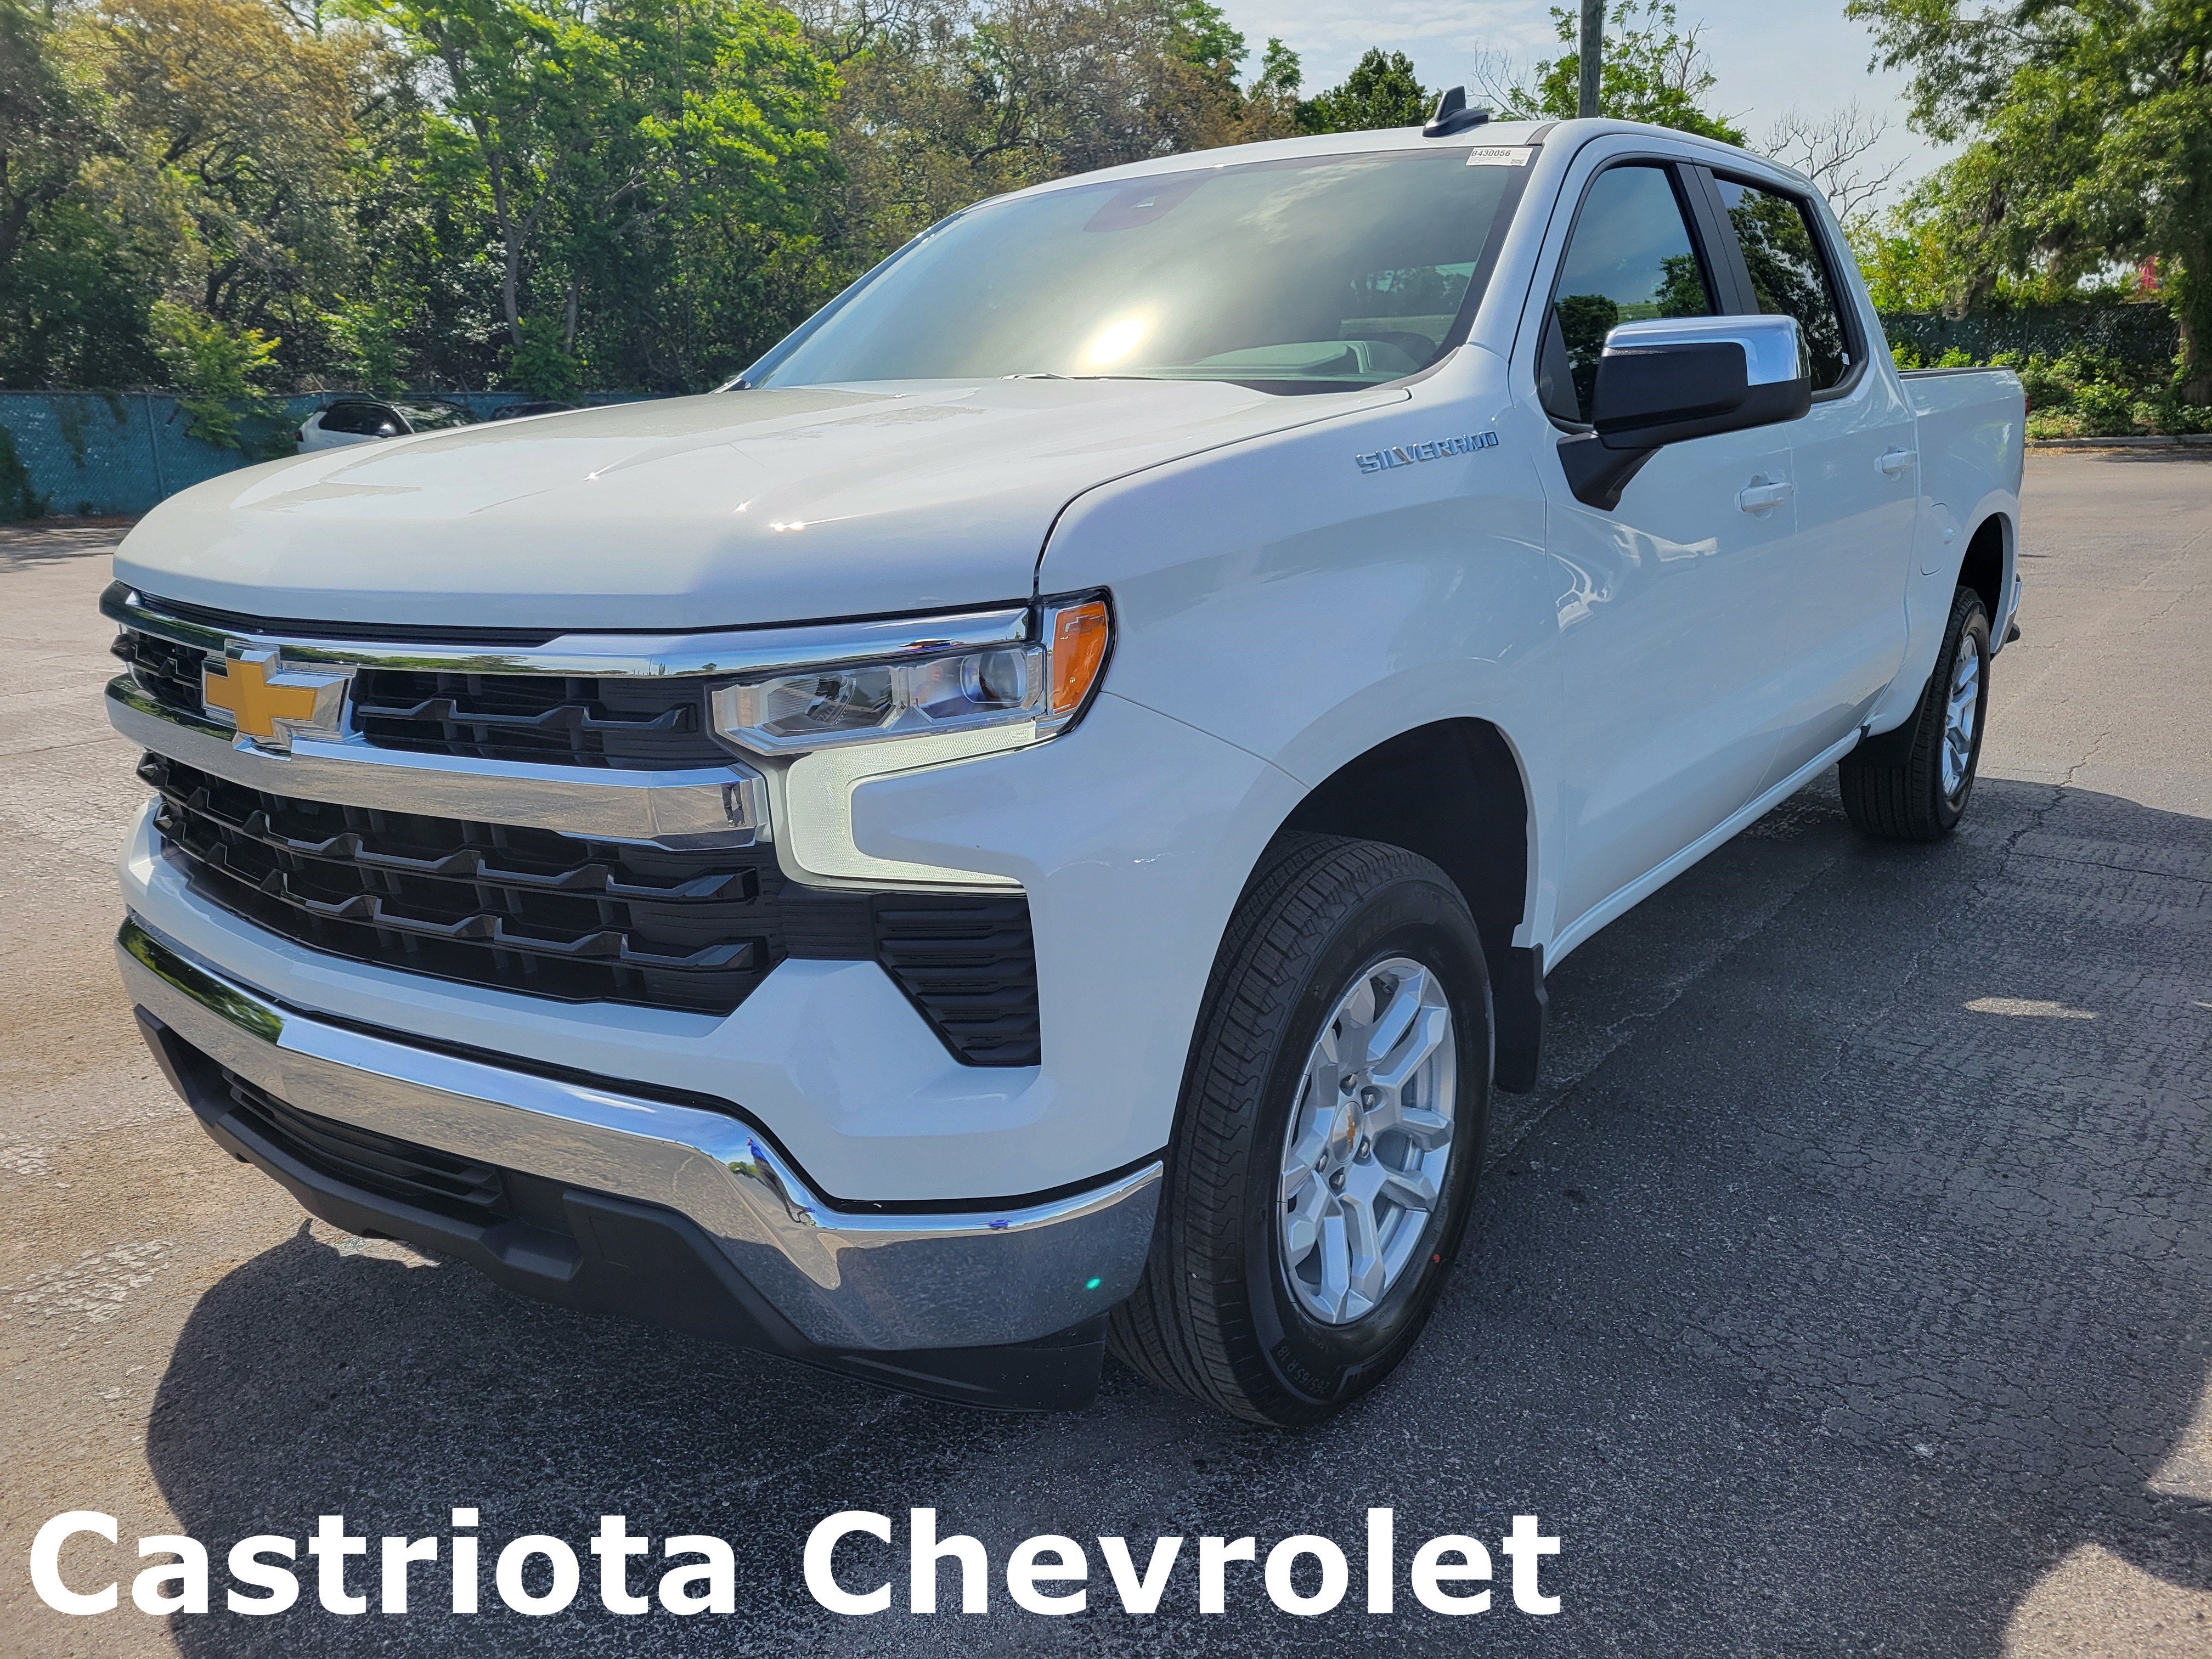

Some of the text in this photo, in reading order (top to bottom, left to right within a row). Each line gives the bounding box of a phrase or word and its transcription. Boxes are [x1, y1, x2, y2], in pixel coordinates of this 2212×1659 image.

[1355, 431, 1499, 474] SILVERADO
[1278, 1345, 1291, 1361] 18
[1294, 1368, 1331, 1394] 265/65
